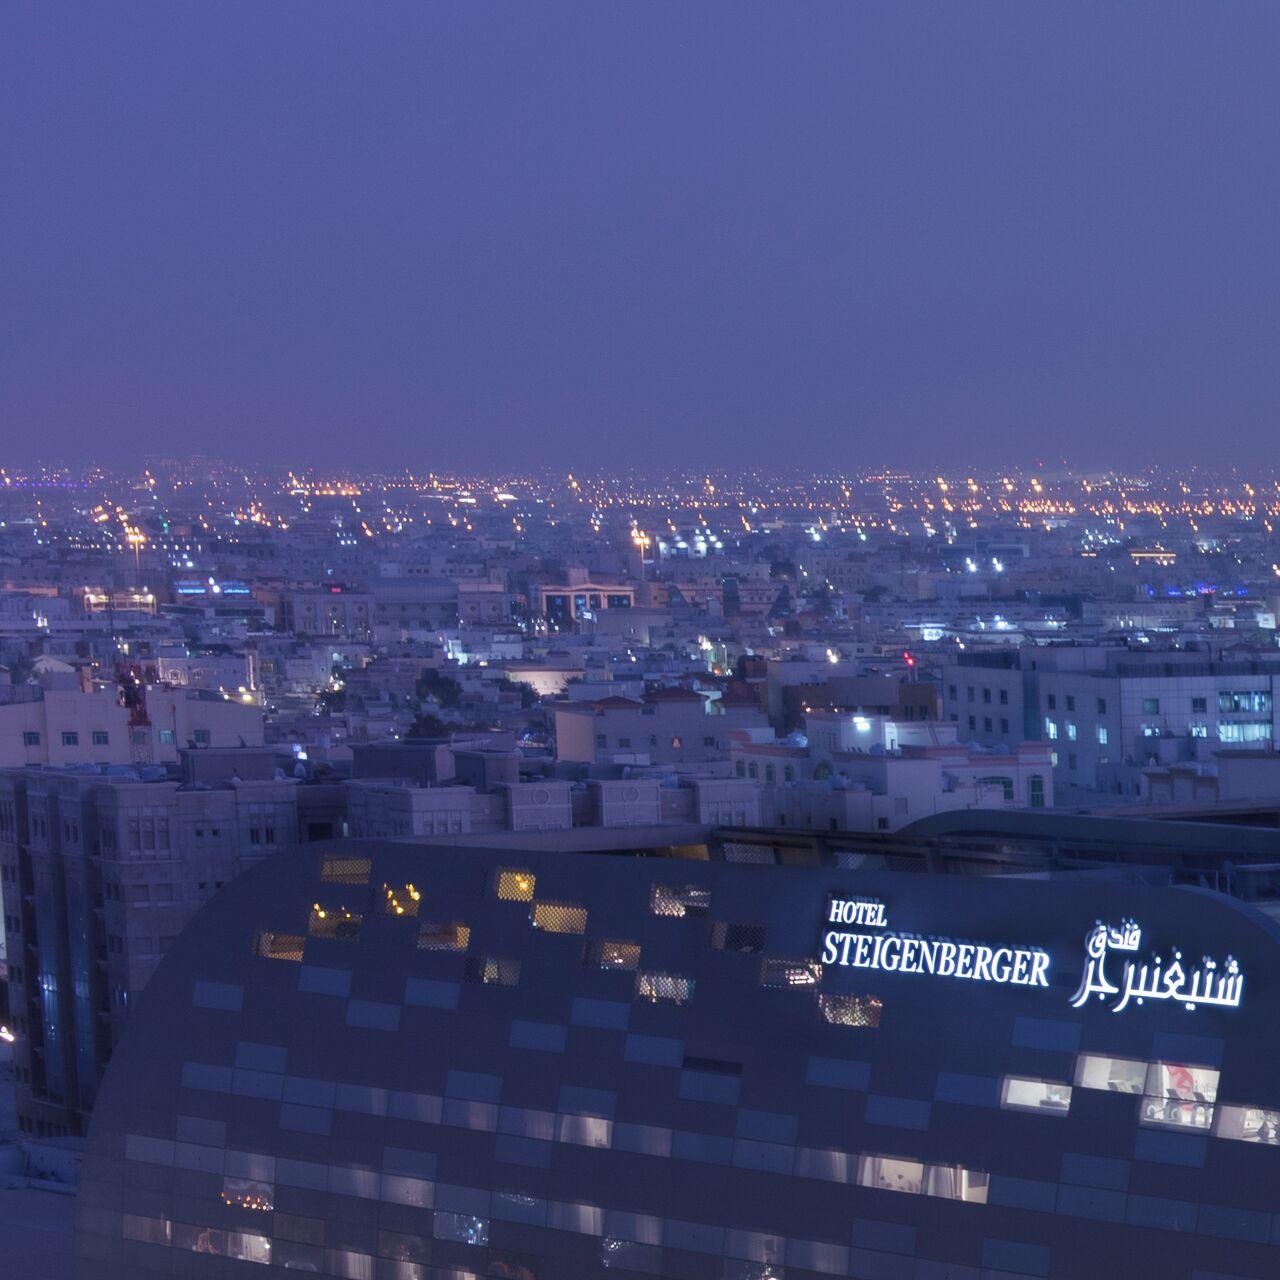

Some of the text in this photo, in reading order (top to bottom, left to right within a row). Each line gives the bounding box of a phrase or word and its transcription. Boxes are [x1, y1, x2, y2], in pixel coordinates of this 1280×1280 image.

[829, 900, 887, 927] HOTEL
[822, 931, 1050, 986] STEIGENBERGER
[1088, 923, 1141, 958] فندق
[1072, 951, 1243, 1013] شتيغنبرجر
